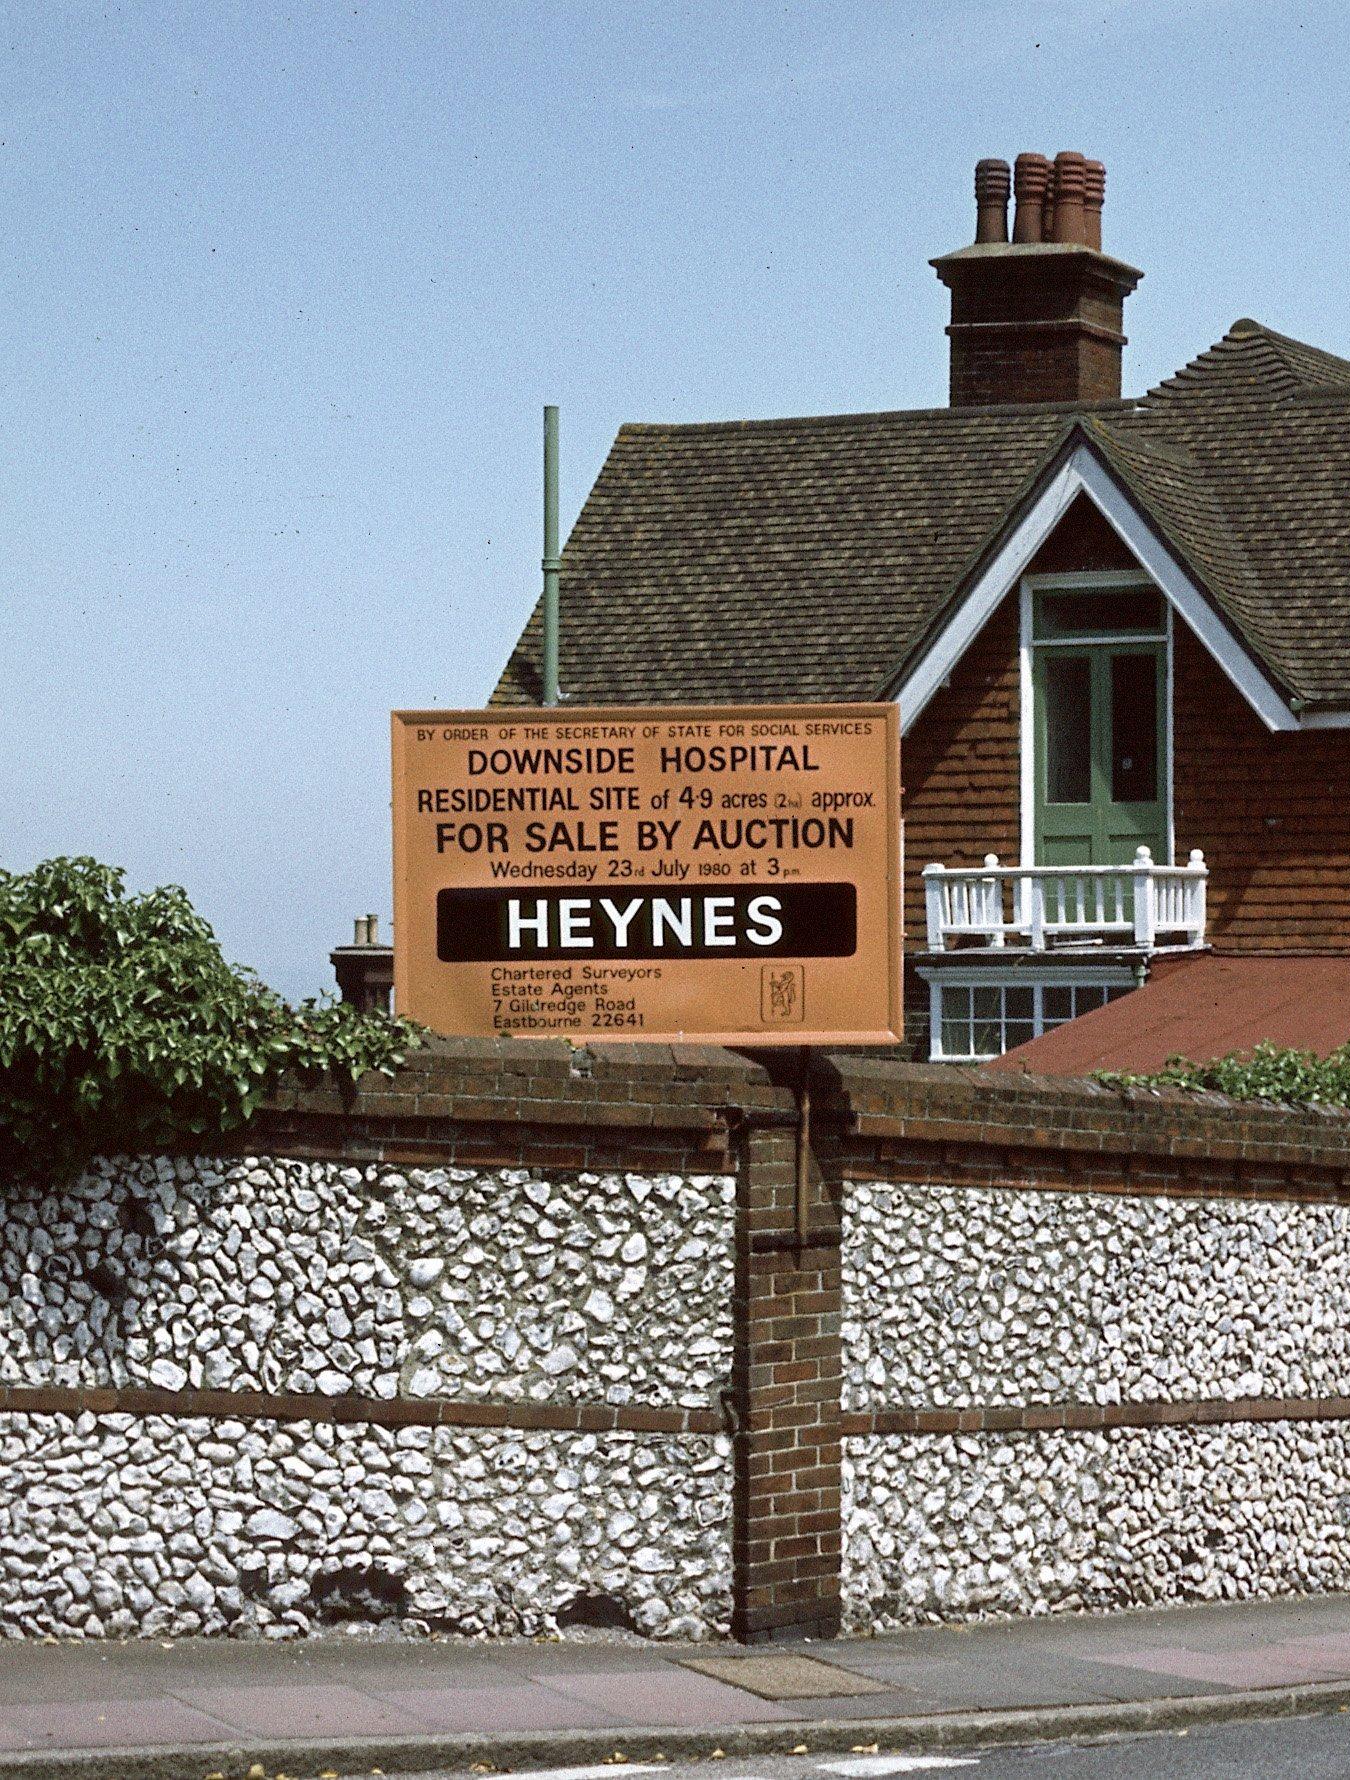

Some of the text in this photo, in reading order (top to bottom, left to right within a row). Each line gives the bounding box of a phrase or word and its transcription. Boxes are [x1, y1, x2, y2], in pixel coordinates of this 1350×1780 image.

[417, 723, 872, 741] BY ORDER OF THE SECRETARY OF STATE FOR SOCIAL SERVICES
[468, 745, 819, 775] DOWNSIDE HOSPITAL
[418, 788, 579, 813] RESIDENTIAL
[589, 786, 640, 810] SITE
[651, 789, 669, 810] of
[722, 792, 767, 808] acres
[437, 818, 854, 853] FOR SALE BY AUCTION
[490, 861, 597, 881] Wednesday
[608, 860, 645, 877] 23rd
[652, 860, 690, 880] July
[699, 863, 731, 876] 1980
[740, 862, 756, 876] at
[508, 896, 783, 948] HEYNES
[491, 966, 662, 982] Chartered Surveyors
[491, 983, 608, 999] Estate Agents
[493, 998, 636, 1015] 7 Gildredge Road
[493, 1014, 644, 1029] Eastbourne 22641
